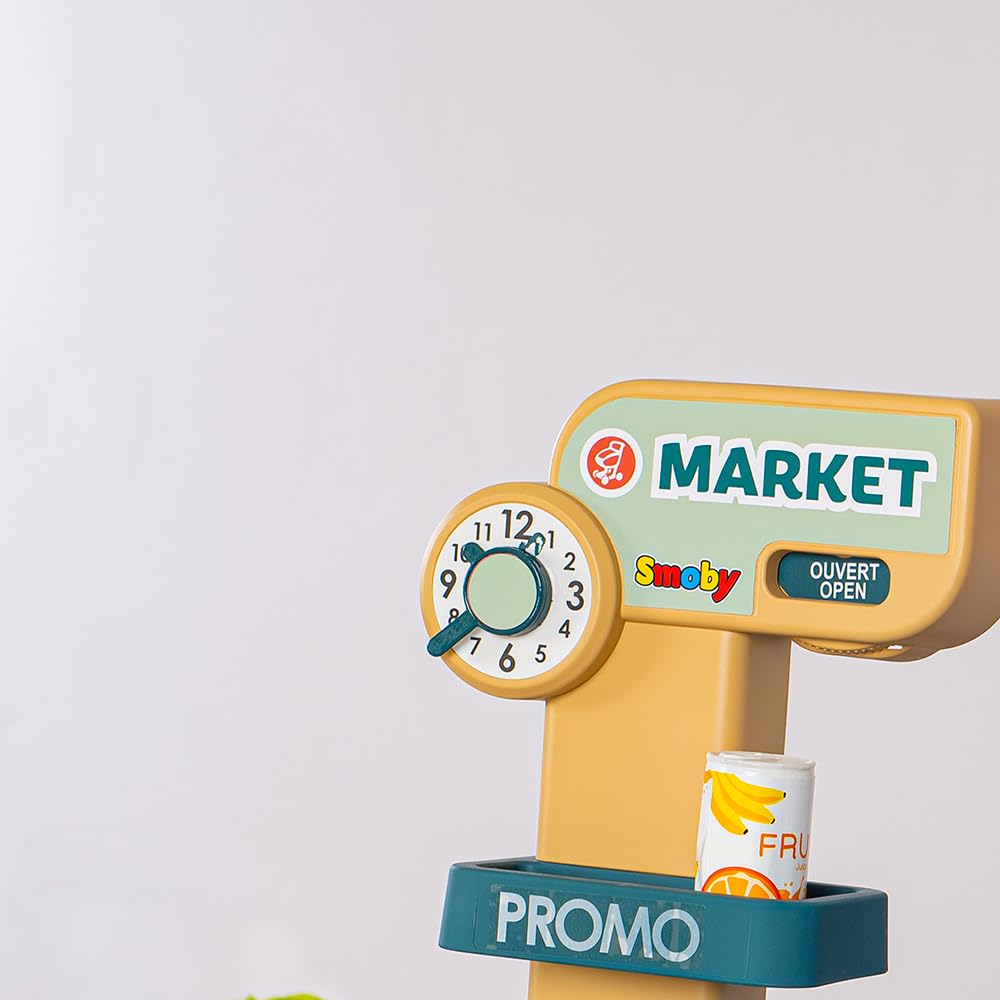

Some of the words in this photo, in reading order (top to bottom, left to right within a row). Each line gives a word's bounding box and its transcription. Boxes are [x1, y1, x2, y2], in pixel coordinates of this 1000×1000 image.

[659, 442, 929, 508] MARKET
[474, 522, 492, 542] 11
[501, 509, 534, 541] 12
[547, 530, 555, 549] 1
[563, 552, 576, 571] 2
[809, 560, 880, 582] OUVERT
[440, 569, 457, 599] 9
[635, 555, 742, 604] Smoby
[819, 581, 867, 600] OPEN
[566, 580, 584, 611] 3
[558, 619, 571, 639] 4
[470, 636, 482, 656] 7
[534, 644, 547, 664] 5
[498, 643, 516, 673] 6
[496, 891, 701, 963] PROMO
